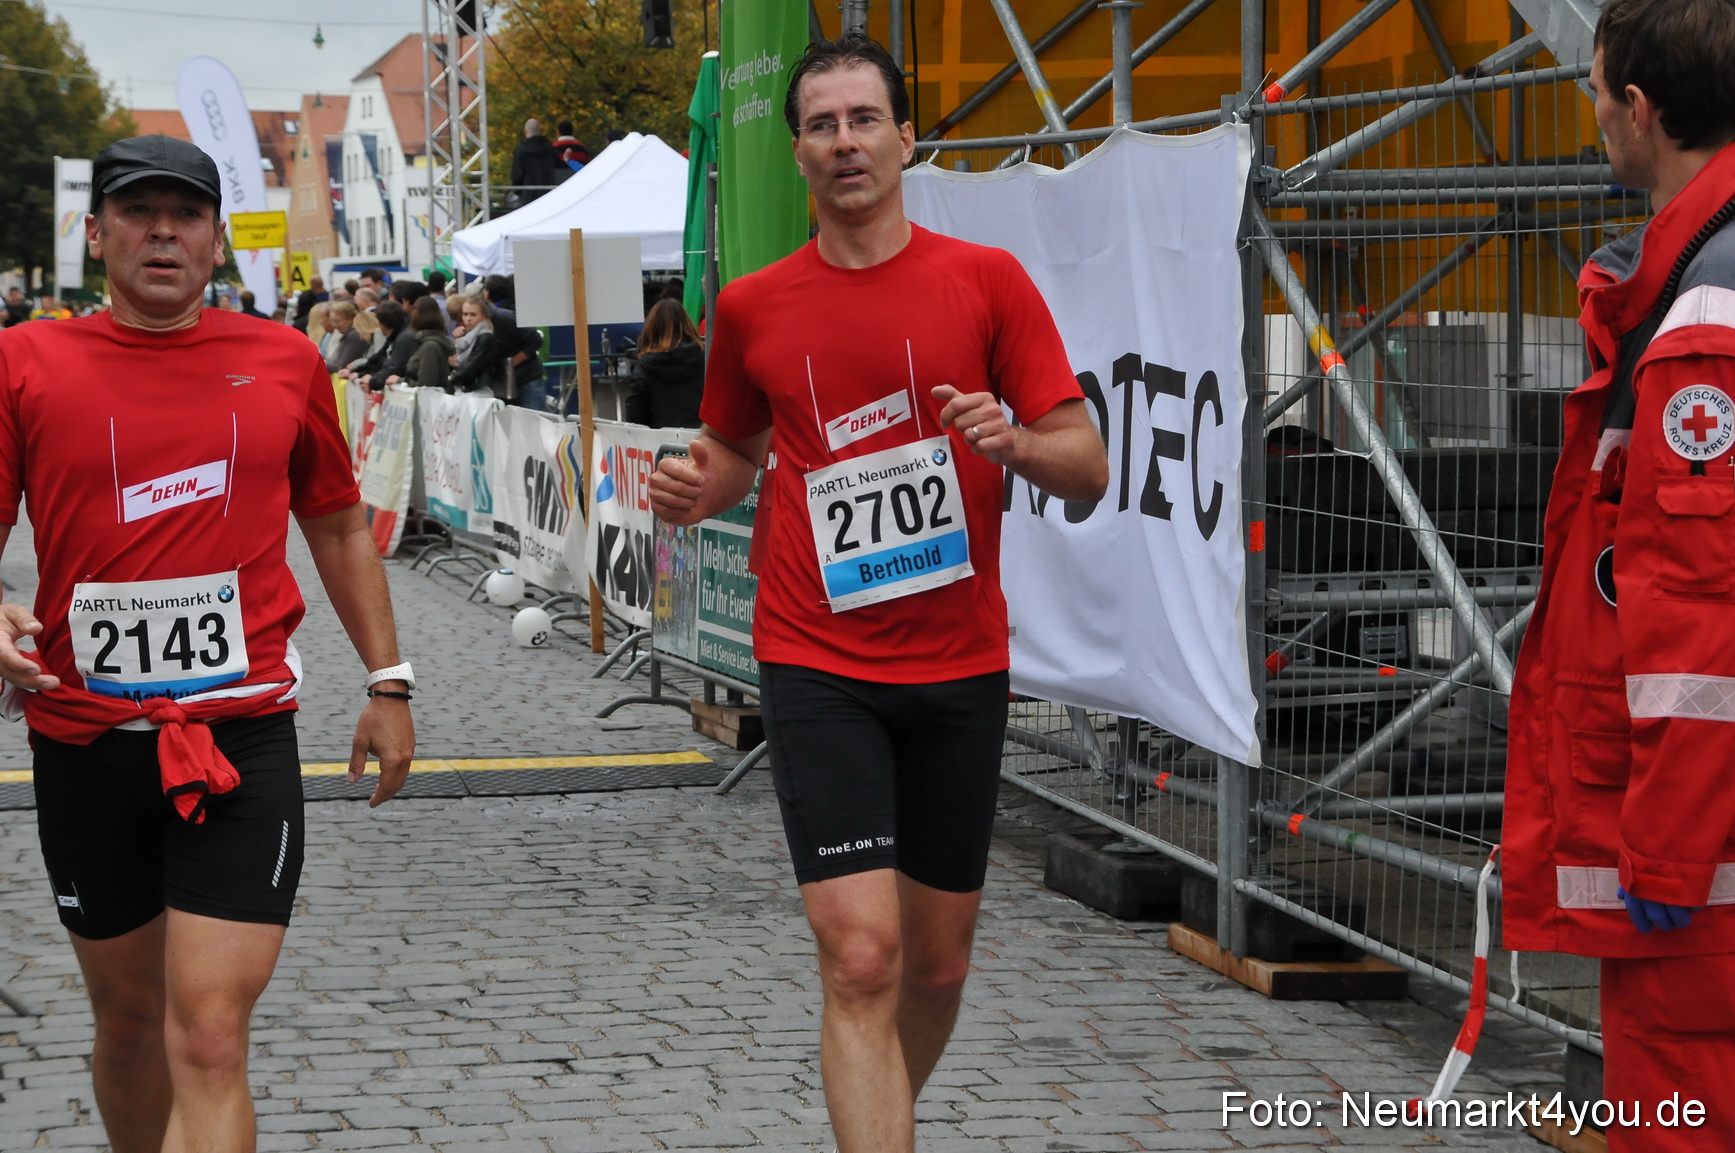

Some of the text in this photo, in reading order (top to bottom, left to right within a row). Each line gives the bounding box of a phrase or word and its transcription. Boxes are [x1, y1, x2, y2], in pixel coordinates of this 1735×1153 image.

[292, 266, 306, 287] A
[850, 406, 887, 434] DEHN
[1669, 390, 1730, 419] DEUTSCHES
[1002, 352, 1224, 541] OTEC
[1669, 422, 1732, 456] ROTES KREUZ
[151, 477, 198, 504] DEHN
[809, 457, 929, 500] PARTL Neumarkt
[827, 475, 953, 555] 2702
[703, 539, 760, 580] Mehr Siche
[824, 553, 832, 563] A
[858, 545, 942, 584] Berthold
[73, 592, 212, 612] PARTL Neumarkt
[702, 579, 715, 612] für
[716, 584, 728, 616] Ihr
[90, 612, 230, 675] 2143
[713, 643, 718, 661] &
[718, 644, 736, 668] Service
